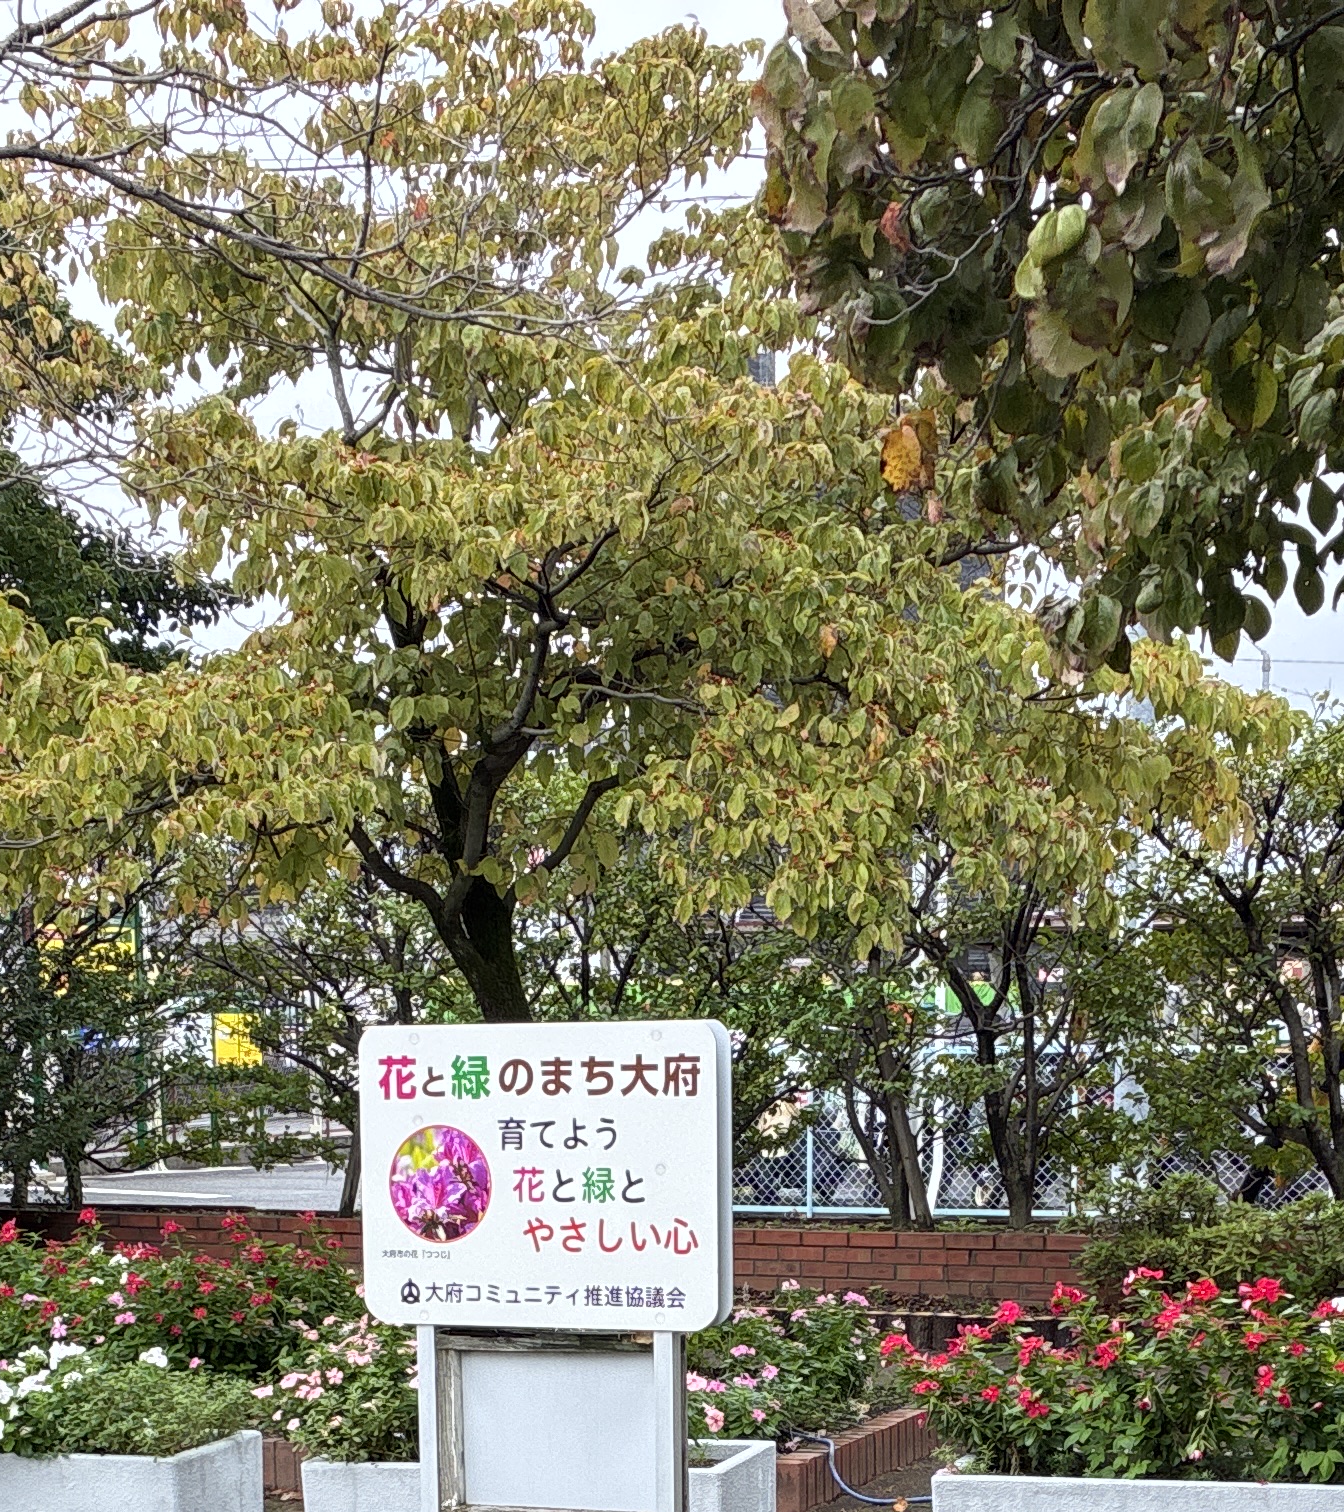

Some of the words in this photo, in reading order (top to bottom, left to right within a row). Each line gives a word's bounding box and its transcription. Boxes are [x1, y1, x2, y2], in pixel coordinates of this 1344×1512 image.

[378, 1053, 701, 1100] 花と緑のまち大府
[497, 1117, 618, 1152] 育てよう
[512, 1166, 646, 1204] 花と緑と
[523, 1216, 699, 1255] やさしい心
[425, 1281, 687, 1309] 大府コミュニティ推進協議会
